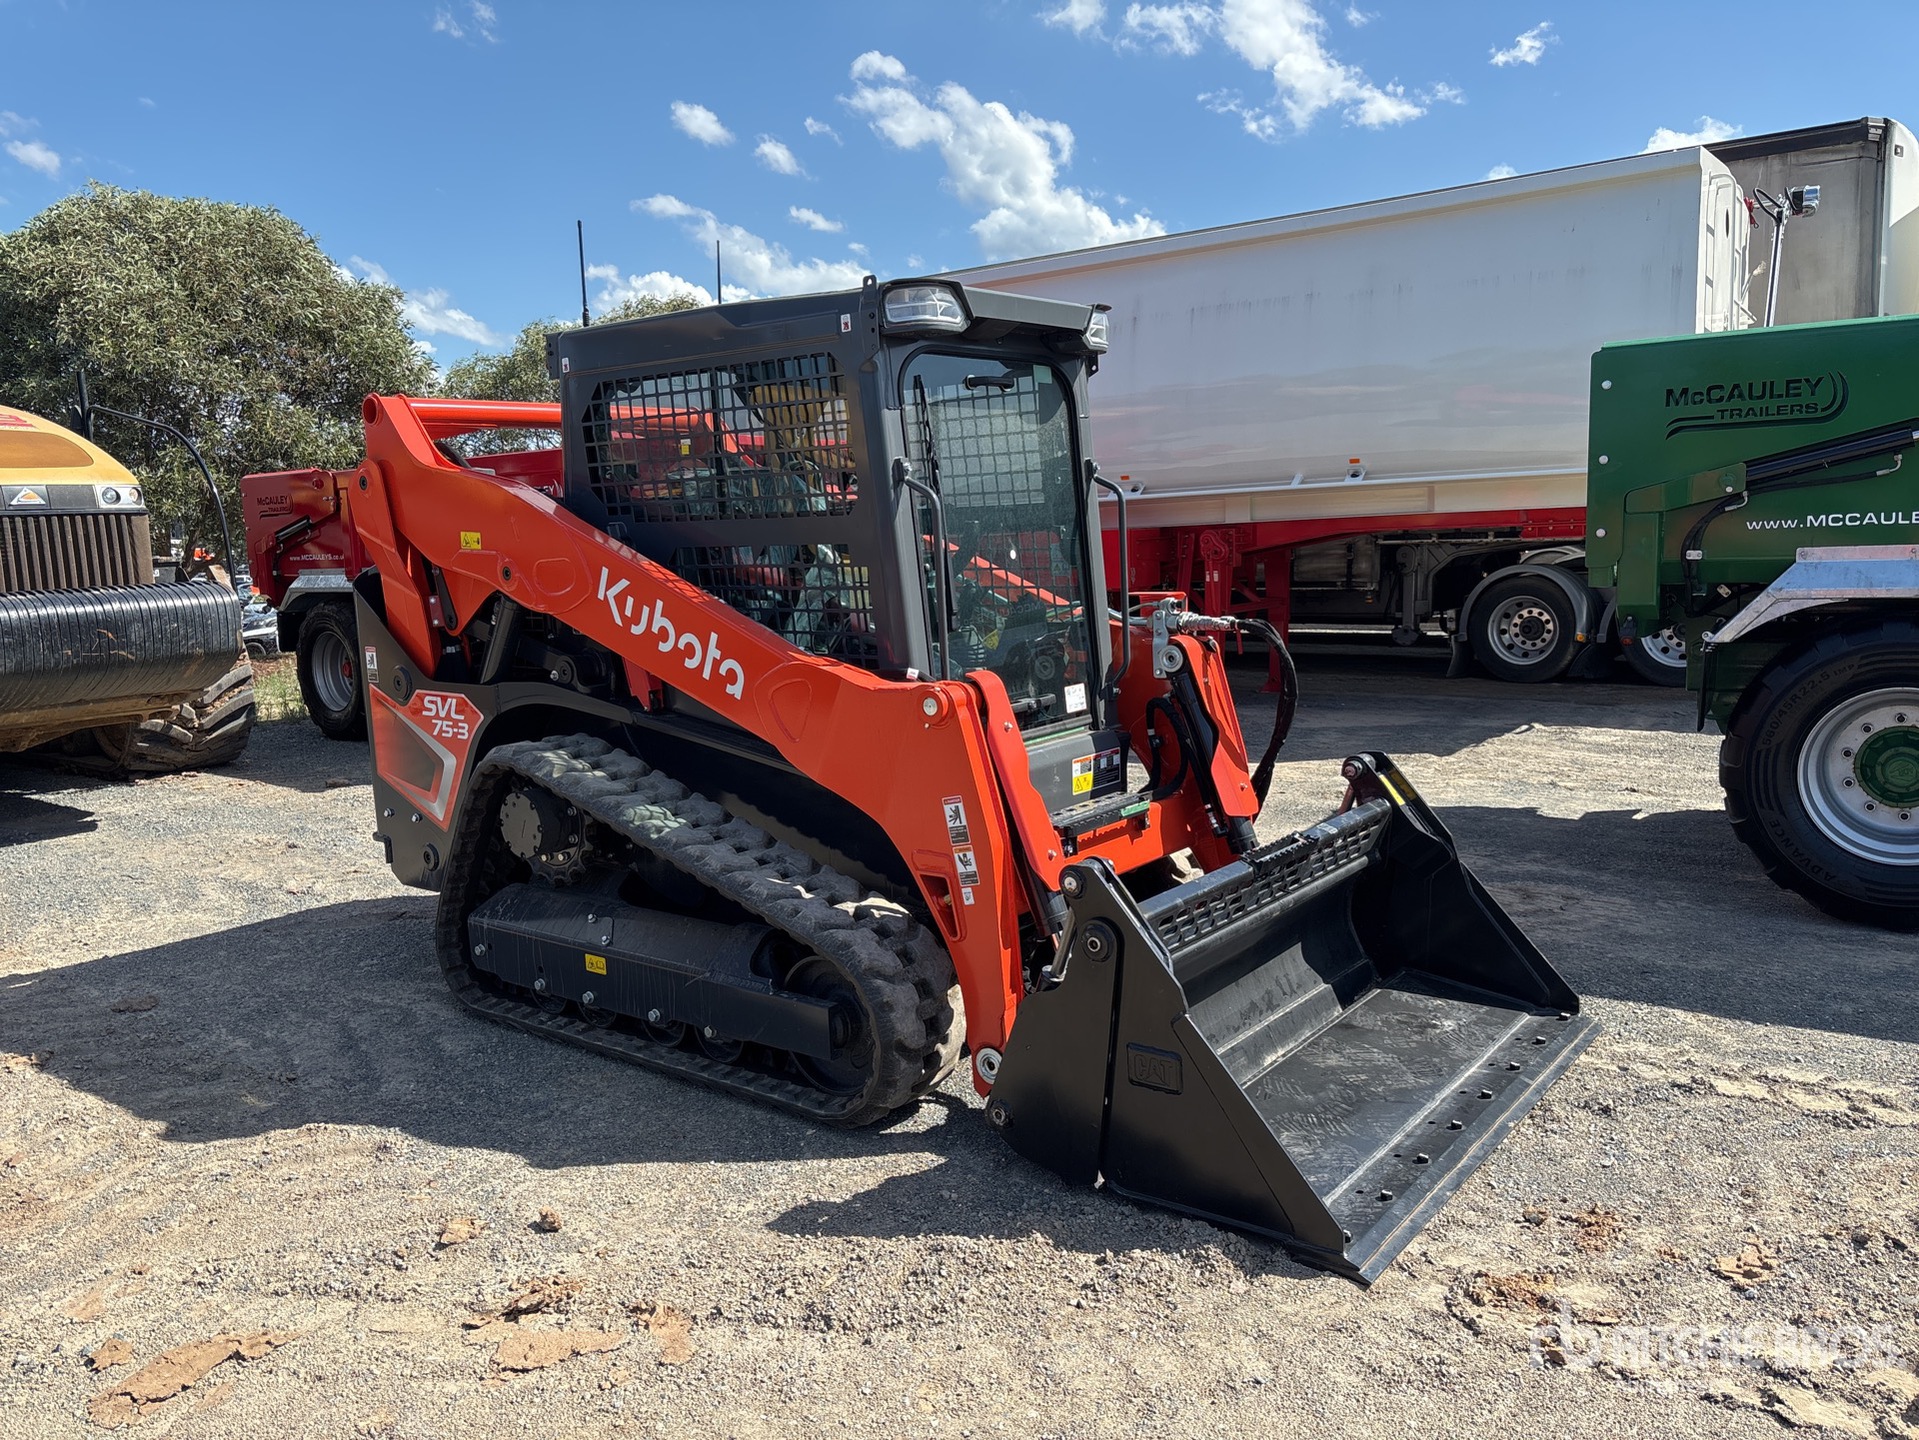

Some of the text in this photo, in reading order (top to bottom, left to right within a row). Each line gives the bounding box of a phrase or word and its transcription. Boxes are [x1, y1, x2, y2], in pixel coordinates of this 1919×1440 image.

[1665, 376, 1825, 407] McCAULEY
[1717, 402, 1819, 420] TRAILERS
[597, 566, 745, 700] Kubota
[422, 695, 465, 720] SVL
[432, 719, 469, 740] 75-3
[1768, 818, 1838, 882] ADVANCE
[1134, 1053, 1178, 1090] CAT
